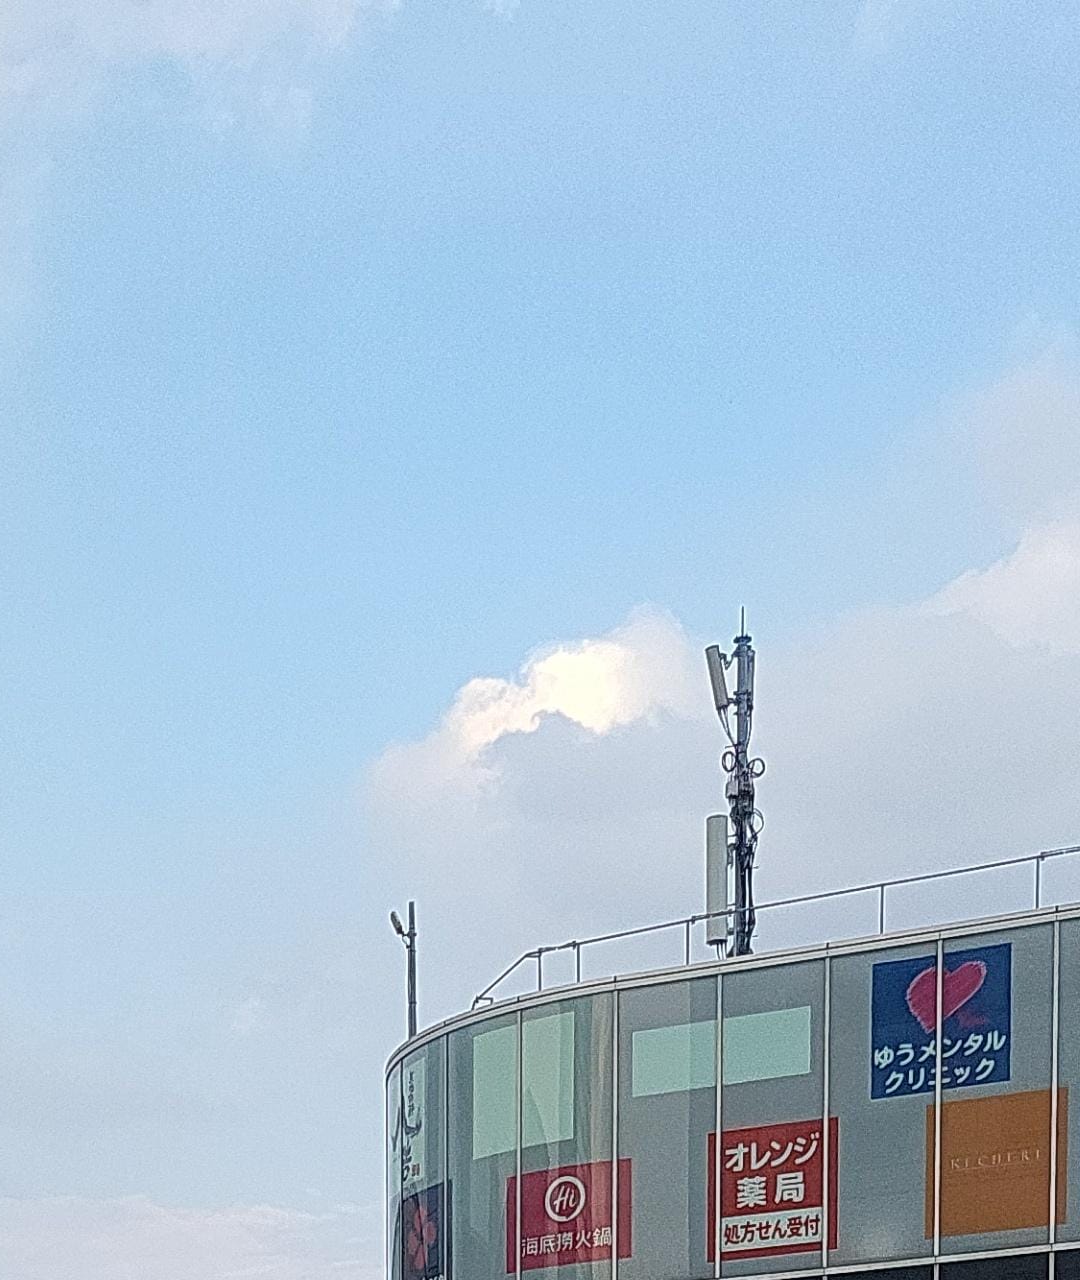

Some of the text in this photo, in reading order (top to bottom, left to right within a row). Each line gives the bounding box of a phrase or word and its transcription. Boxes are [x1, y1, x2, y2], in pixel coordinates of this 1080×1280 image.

[874, 1030, 1006, 1069] ゆうメンタル
[885, 1057, 995, 1094] クリニック
[725, 1132, 820, 1172] オレンジ
[737, 1172, 805, 1209] 薬局
[724, 1214, 821, 1246] 処方せん受付
